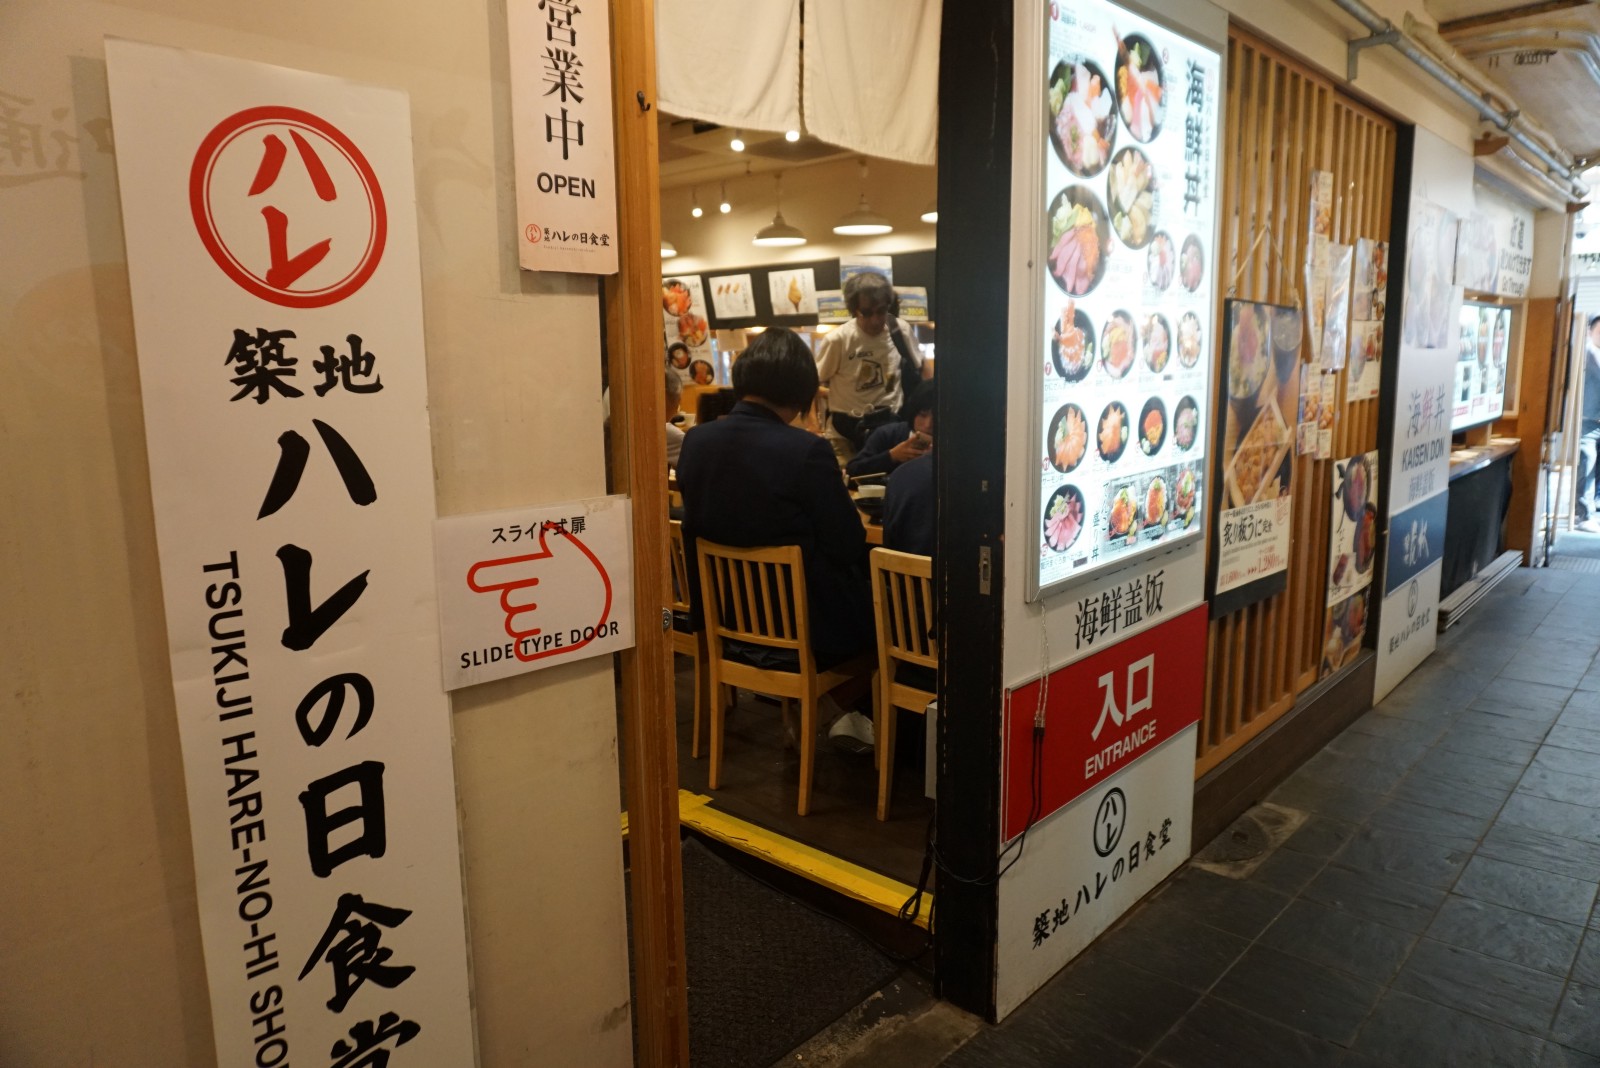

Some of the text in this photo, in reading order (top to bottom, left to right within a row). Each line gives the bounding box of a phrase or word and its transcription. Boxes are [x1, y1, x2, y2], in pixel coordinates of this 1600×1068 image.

[538, 0, 585, 161] 営業中
[1184, 58, 1205, 218] 海鮮丼
[248, 129, 338, 290] ハレ
[537, 171, 596, 199] OPEN
[225, 327, 384, 405] 築地
[1407, 384, 1446, 439] 海鮮丼
[1402, 442, 1429, 472] KAISEN
[1430, 436, 1446, 461] DON
[491, 516, 586, 543] スライド式扉
[461, 621, 619, 669] SLIDE TYPE DOOR
[1091, 653, 1155, 742] 入口
[1084, 719, 1157, 780] ENTRANCE
[202, 551, 290, 1068] TSUKIJI HARE-NO-HI SHO
[1102, 796, 1118, 851] ハレ
[1032, 817, 1172, 950] 築地ハレの日食堂
